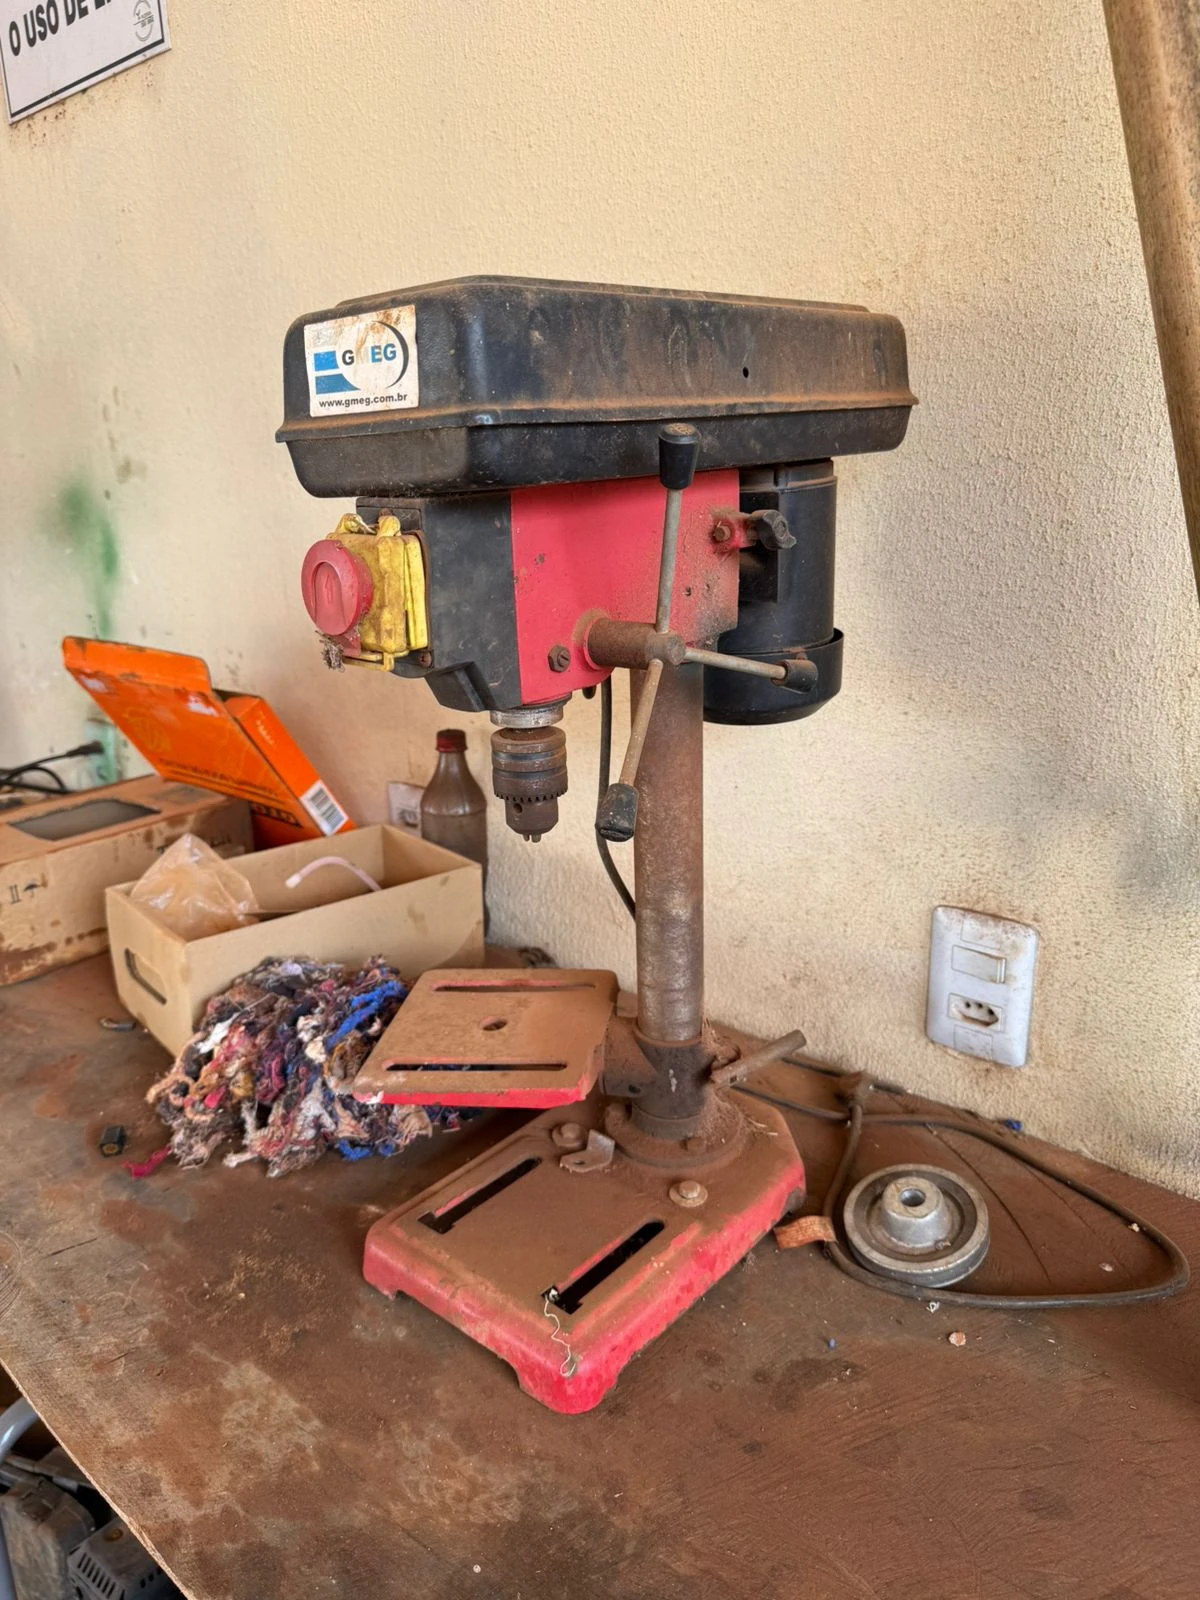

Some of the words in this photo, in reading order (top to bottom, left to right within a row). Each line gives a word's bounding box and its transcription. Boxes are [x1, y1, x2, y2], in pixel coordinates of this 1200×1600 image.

[9, 21, 20, 56] O
[23, 0, 59, 47] USO
[64, 0, 88, 26] DE
[342, 343, 397, 366] GEG
[319, 393, 408, 408] www.gmeg.com.br
